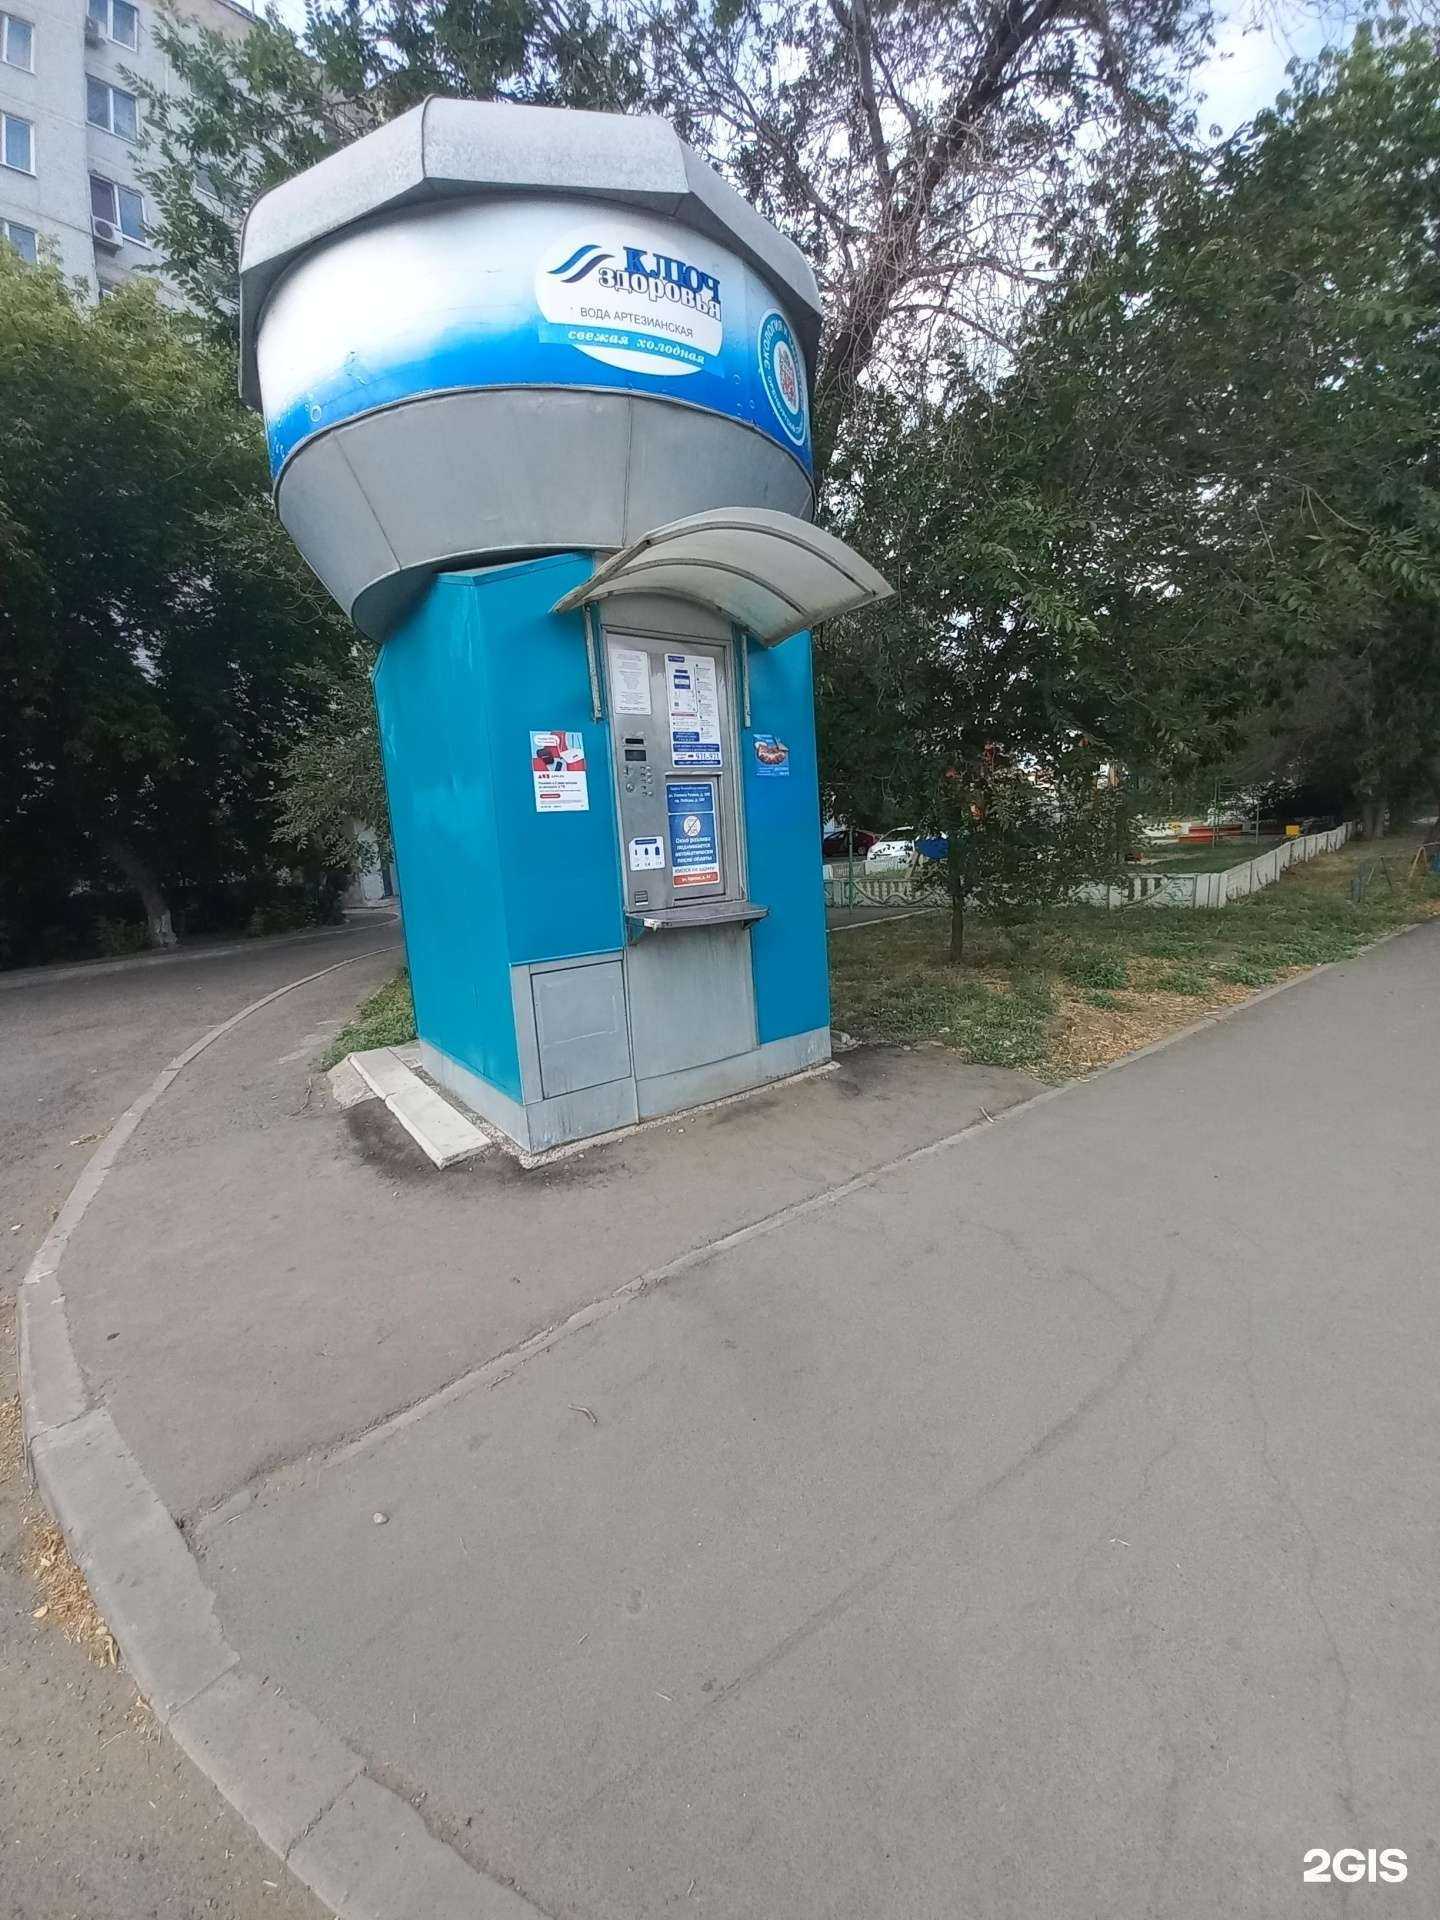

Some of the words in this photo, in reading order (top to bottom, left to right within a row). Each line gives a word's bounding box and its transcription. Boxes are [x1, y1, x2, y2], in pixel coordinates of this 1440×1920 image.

[623, 246, 721, 305] КЛЮЧ
[580, 307, 611, 320] ВОДА
[613, 311, 694, 338] АРТЕЗИАНСКАЯ
[568, 330, 630, 346] свежая
[636, 337, 705, 365] холодная
